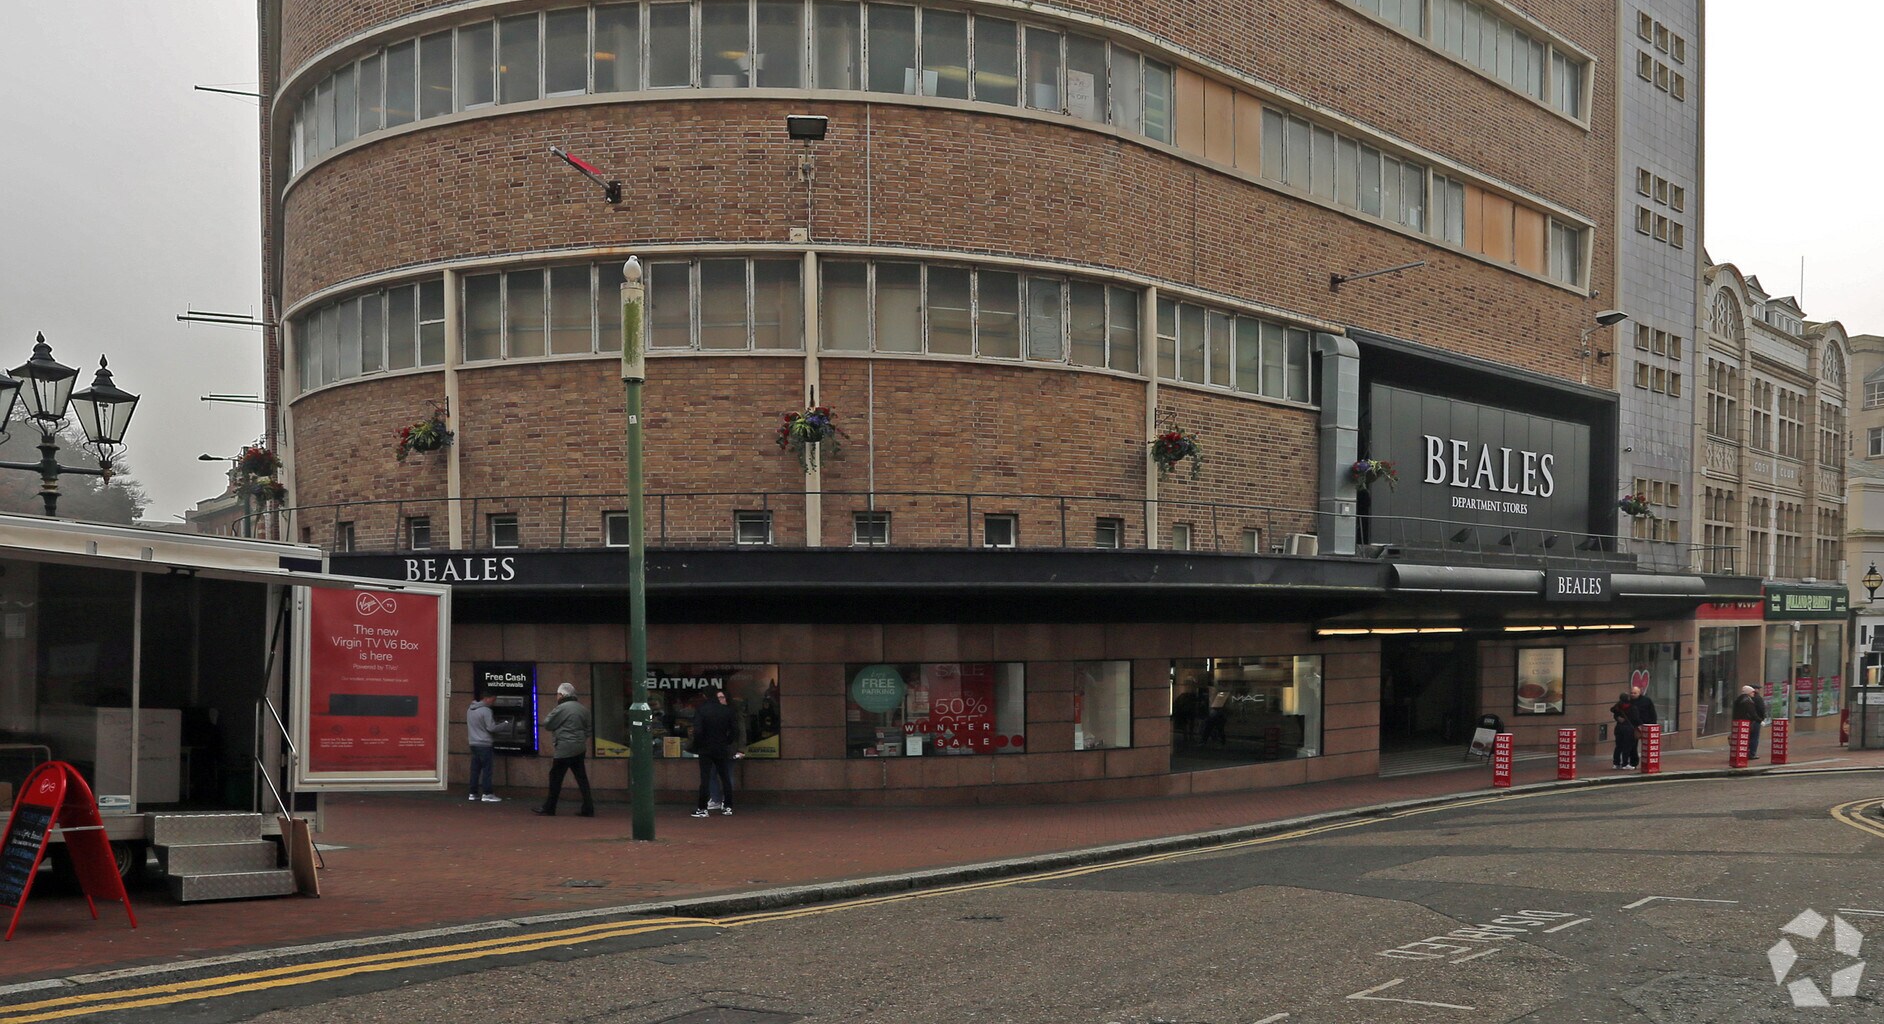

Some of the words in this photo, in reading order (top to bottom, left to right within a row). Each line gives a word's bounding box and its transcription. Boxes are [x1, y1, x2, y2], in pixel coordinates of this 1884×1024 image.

[1424, 434, 1554, 498] BEALES
[1754, 461, 1769, 473] COSY
[1780, 467, 1794, 479] CLUB
[1452, 496, 1502, 512] DEPARTMENT
[1502, 501, 1528, 515] STORES
[404, 557, 515, 582] BEALES
[1557, 576, 1602, 595] BEALES
[353, 624, 375, 636] The
[377, 628, 399, 637] new
[331, 636, 362, 649] Virgin
[365, 637, 381, 649] TV
[383, 639, 398, 649] V6
[400, 640, 419, 650] Box
[359, 650, 367, 661] is
[370, 651, 393, 661] here
[485, 672, 504, 681] Free
[505, 673, 527, 682] Cash
[935, 663, 985, 677] SALE
[646, 678, 723, 690] BATMAN
[861, 678, 895, 688] FREE
[934, 697, 988, 714] 50%
[904, 722, 991, 733] WINTER
[936, 737, 990, 747] SALE
[1373, 909, 1577, 960] DISABLED
